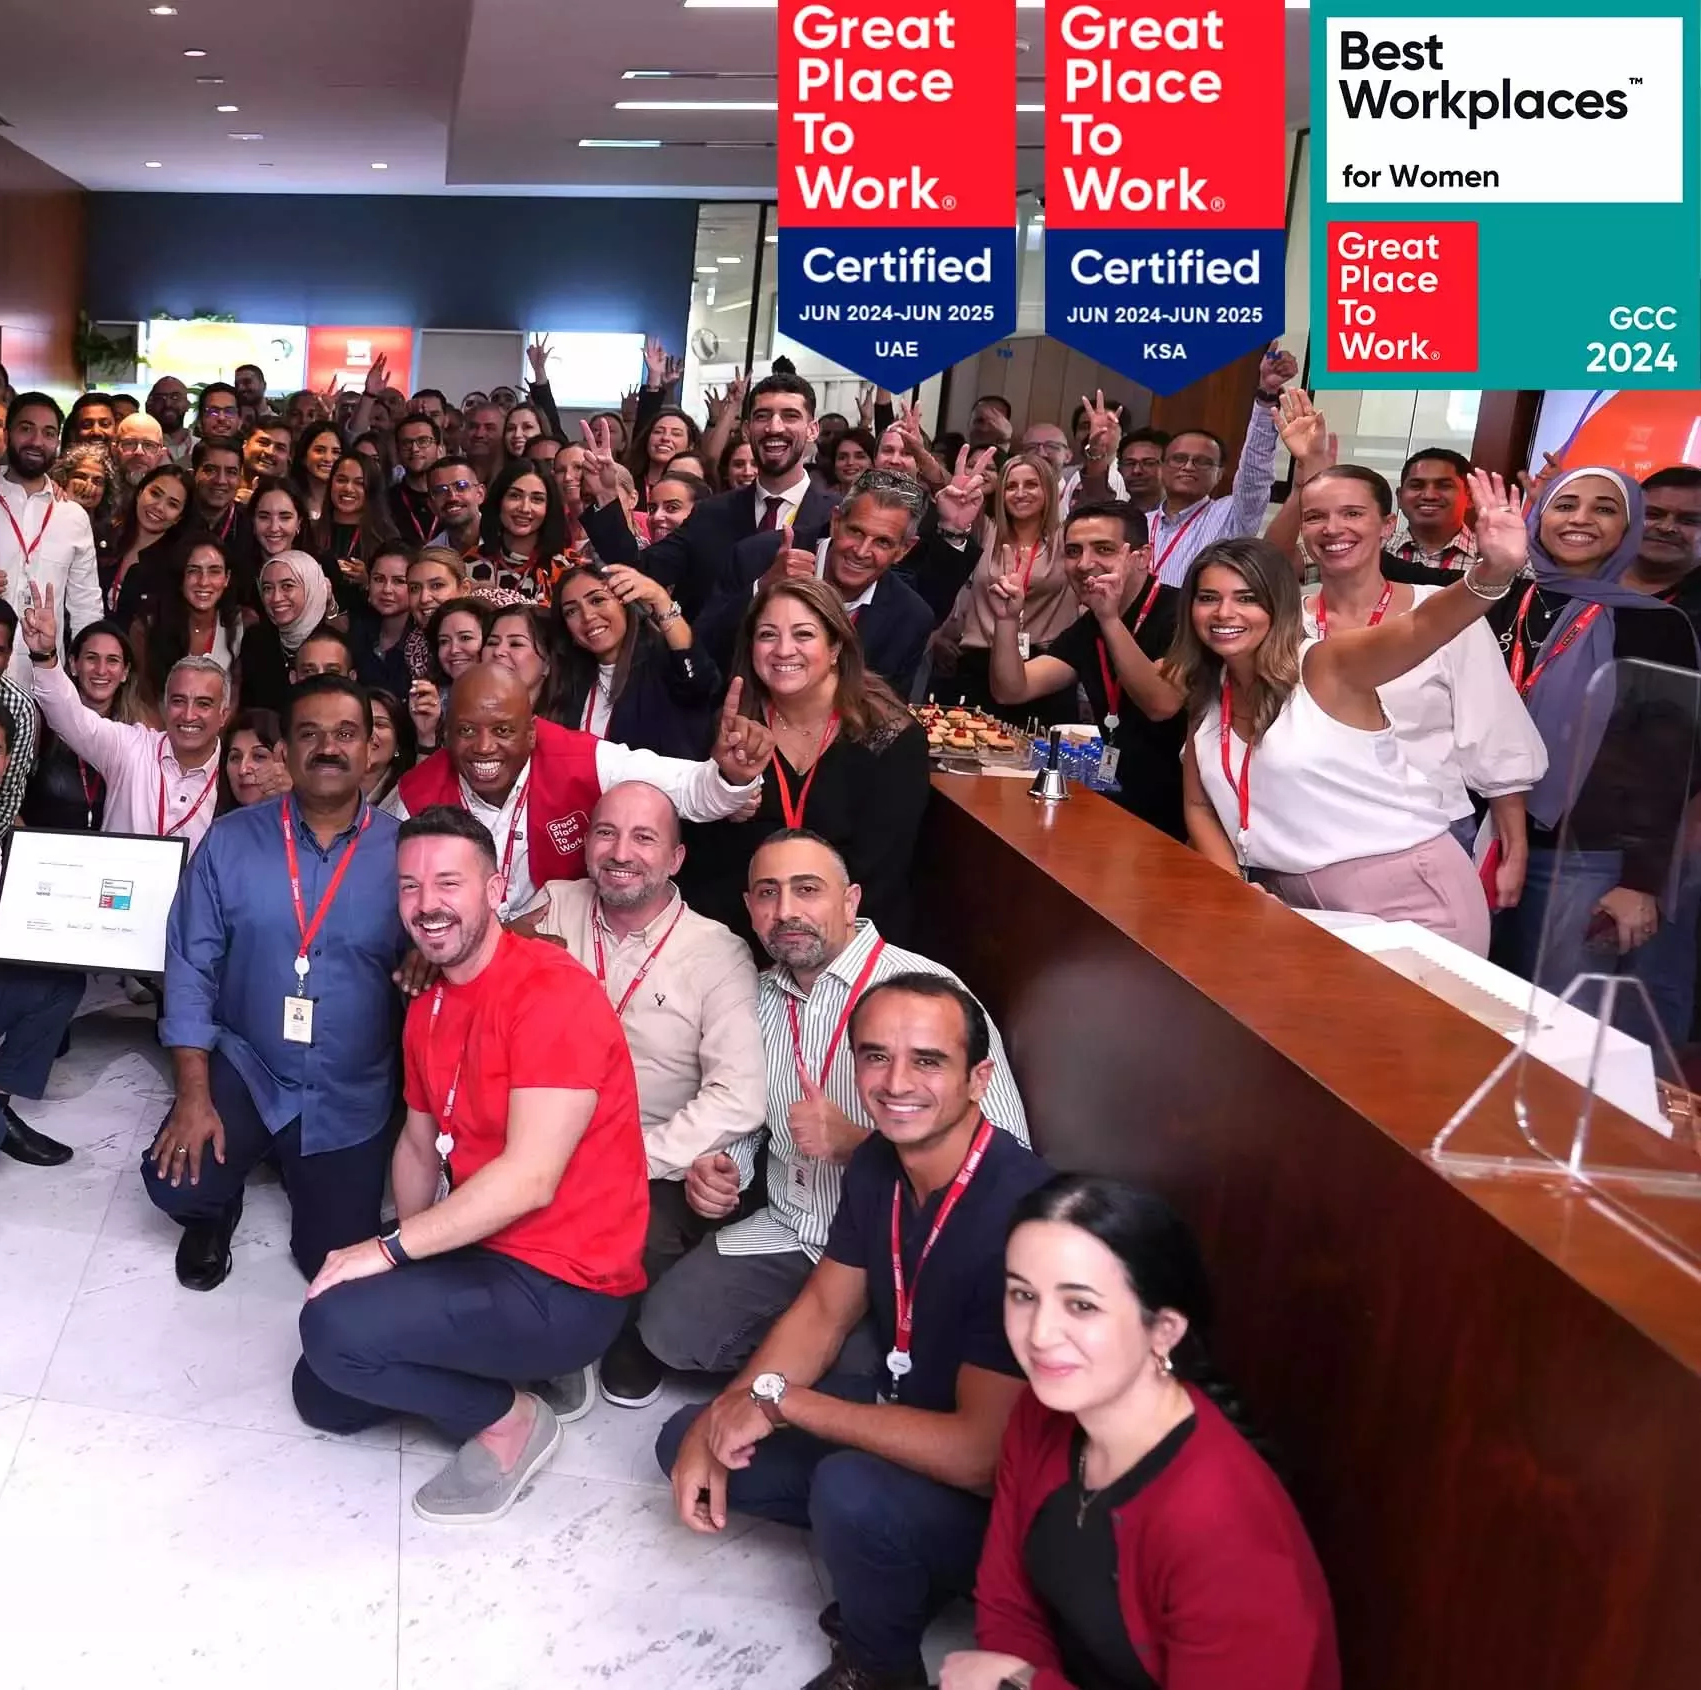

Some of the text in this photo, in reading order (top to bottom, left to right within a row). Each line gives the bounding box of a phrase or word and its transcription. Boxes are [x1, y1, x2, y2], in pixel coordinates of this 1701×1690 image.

[549, 816, 576, 831] Great
[553, 824, 579, 838] Place
[556, 837, 568, 846] To
[560, 837, 583, 852] Work
